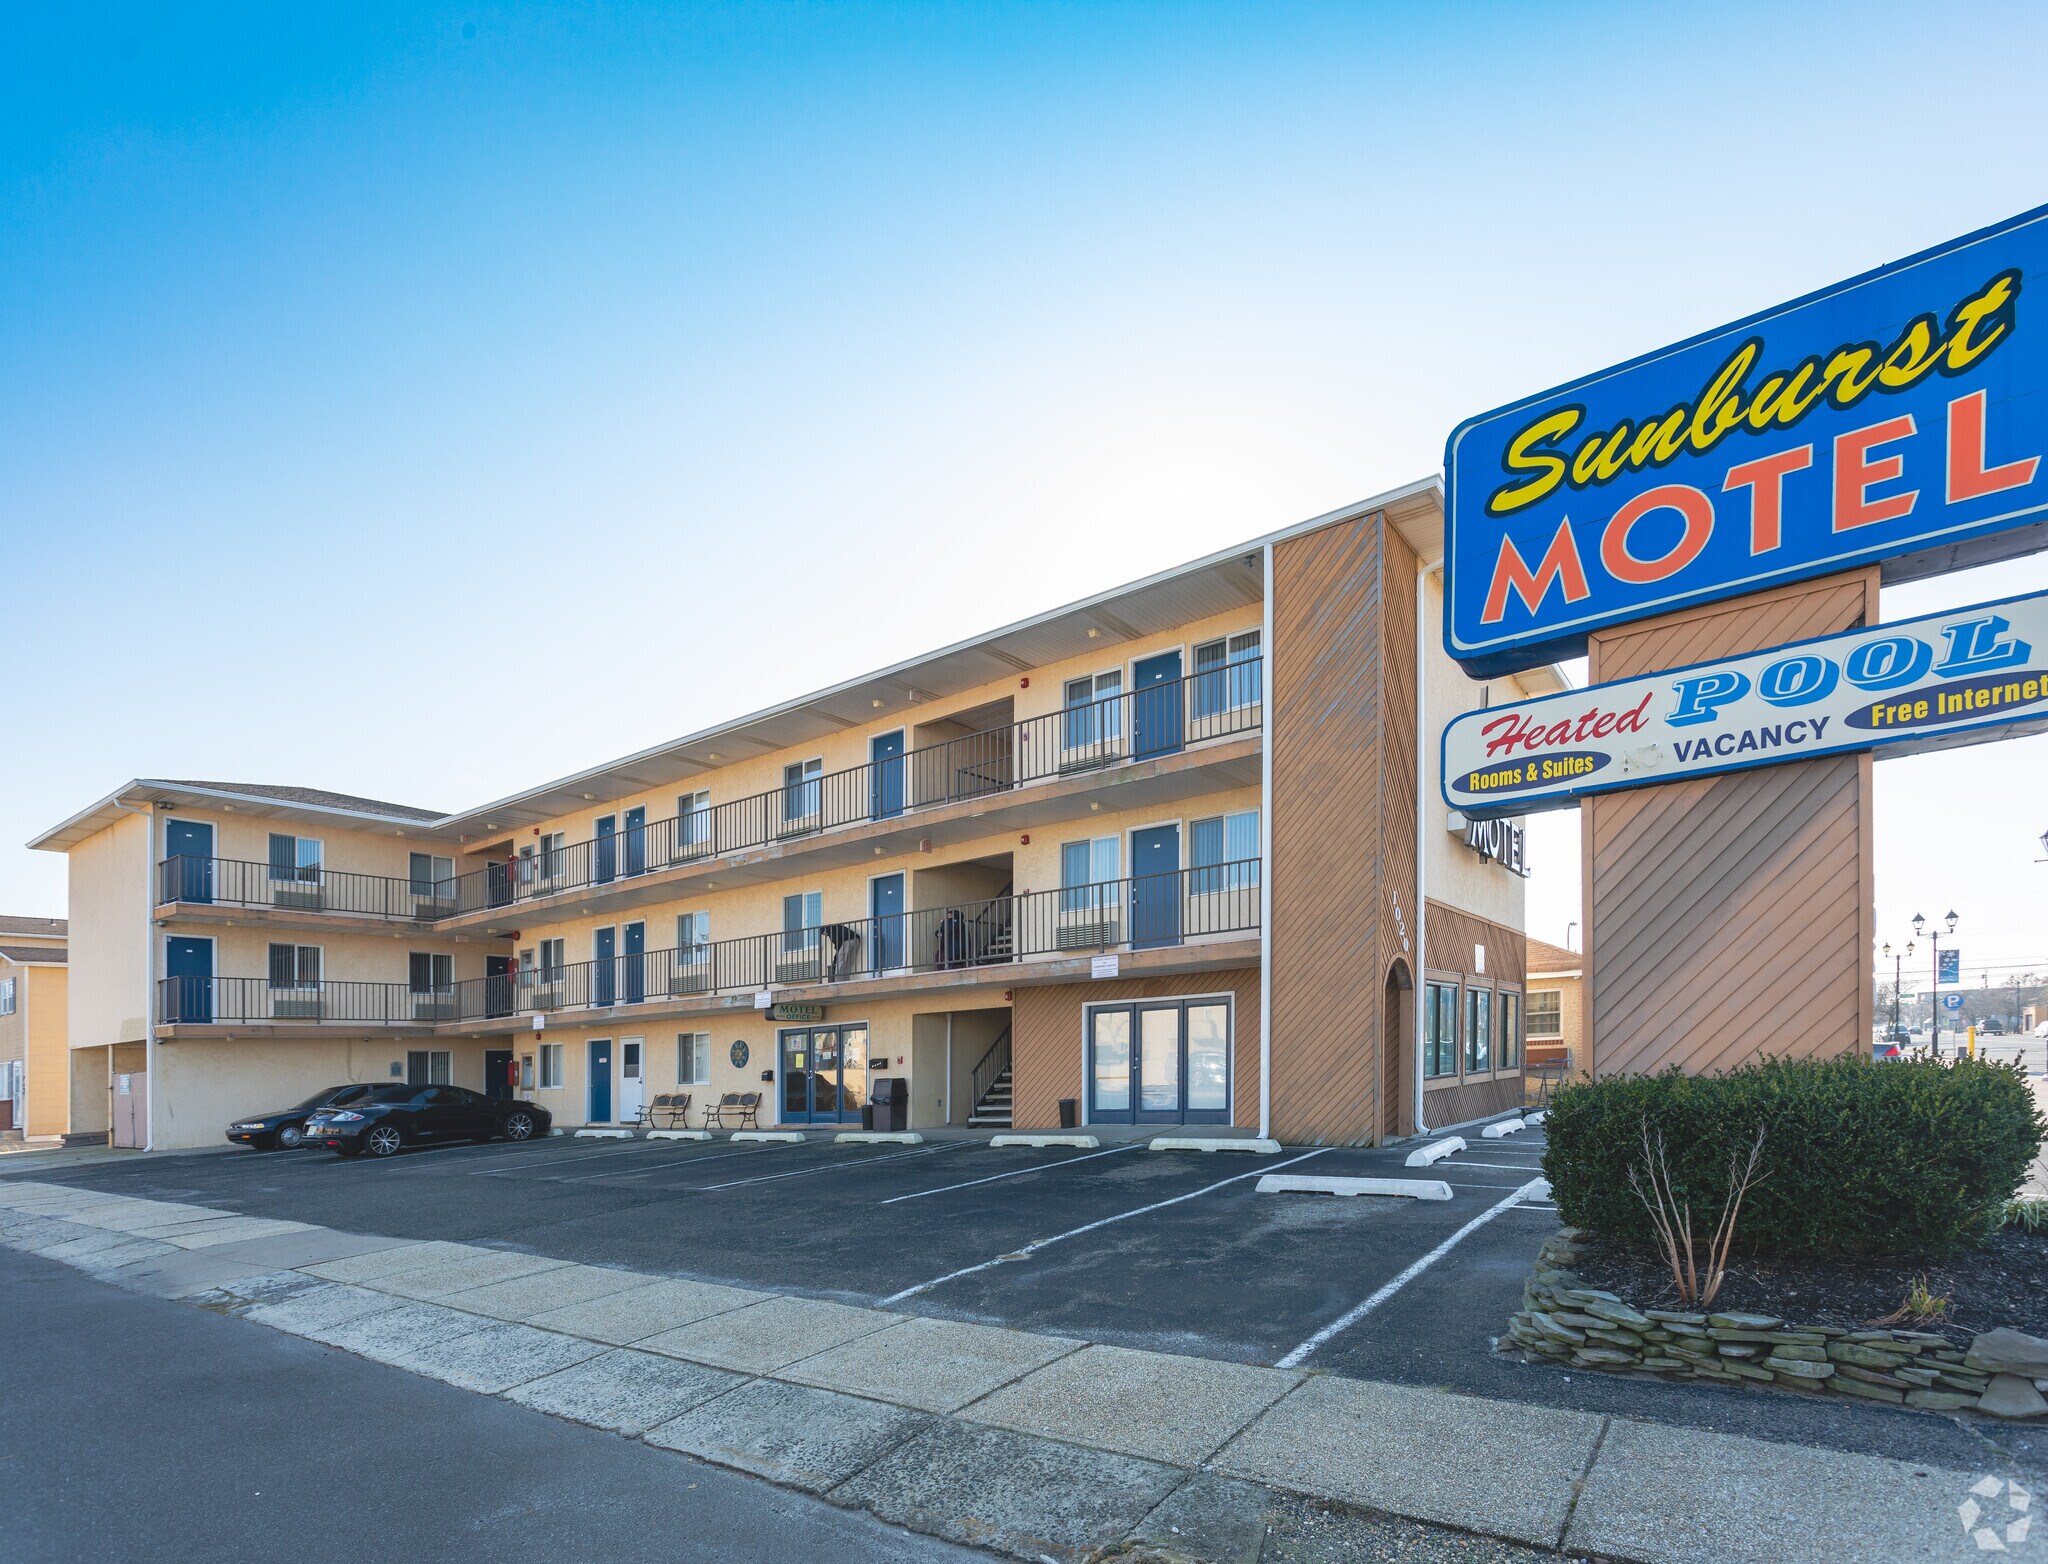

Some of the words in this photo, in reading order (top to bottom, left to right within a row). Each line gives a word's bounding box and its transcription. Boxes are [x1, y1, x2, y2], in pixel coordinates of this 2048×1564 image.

[1486, 270, 2020, 516] Sunburst
[1480, 388, 2043, 625] MOTEL
[1481, 691, 1653, 758] Heated
[1664, 615, 2033, 728] POOL
[1871, 699, 1929, 727] Free
[1938, 674, 2048, 715] Internet
[1673, 716, 1831, 763] VACANCY
[1469, 767, 1522, 792] Rooms
[1526, 762, 1538, 782] &
[1542, 755, 1594, 780] Suites
[1469, 817, 1531, 878] MOTEL
[780, 1005, 818, 1014] MOTEL
